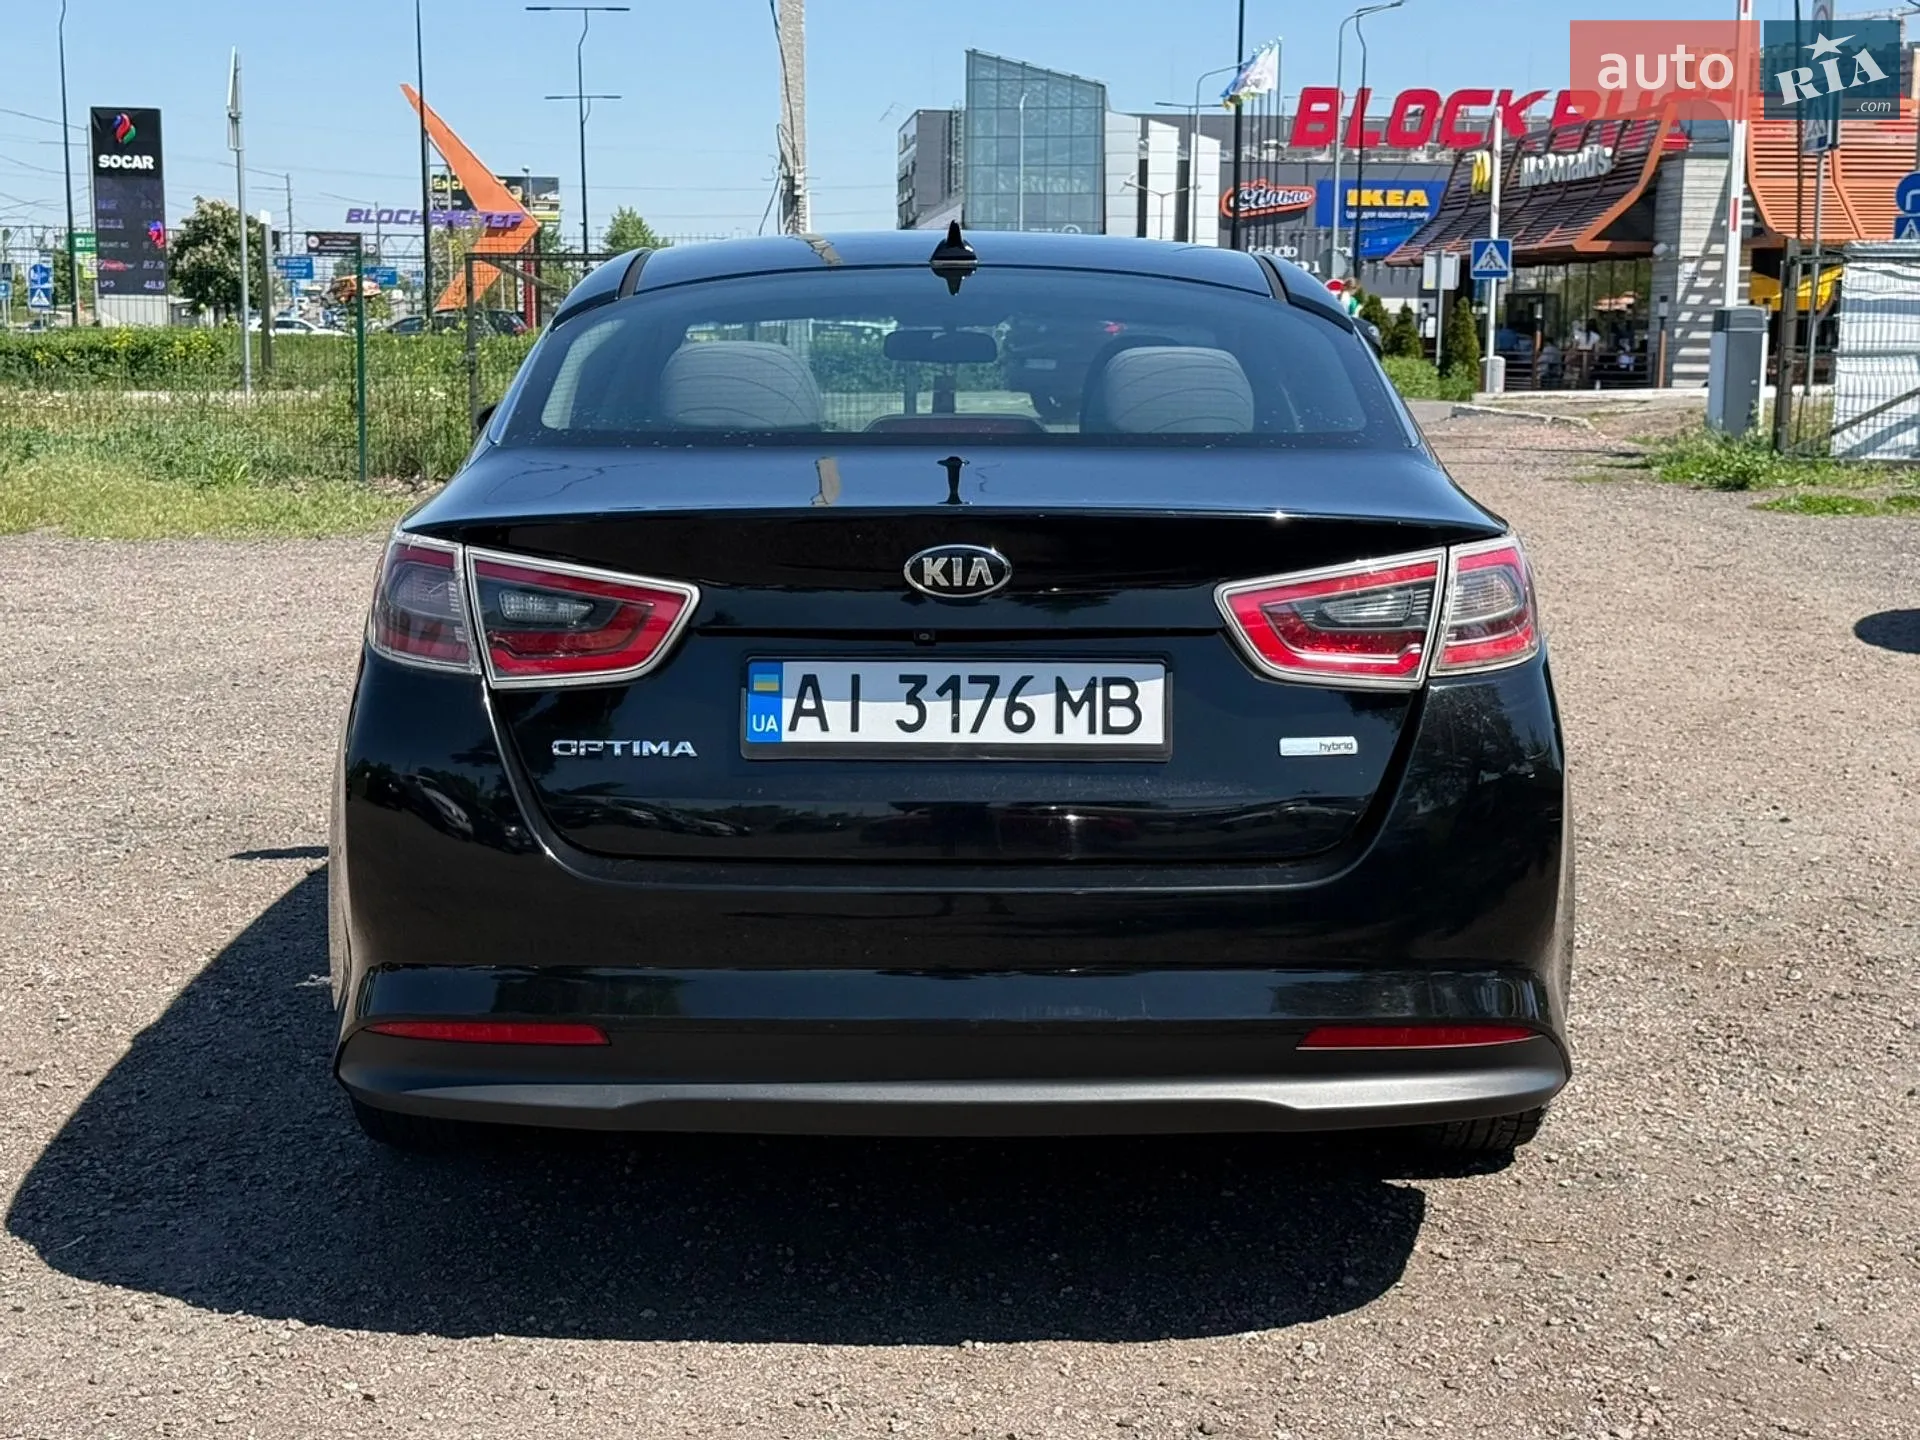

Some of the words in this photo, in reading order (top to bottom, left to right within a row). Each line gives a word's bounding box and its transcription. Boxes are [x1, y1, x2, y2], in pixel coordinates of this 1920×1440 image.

[98, 154, 154, 170] SOCAR
[1346, 188, 1430, 207] IKEA
[922, 557, 994, 587] KIA
[788, 673, 861, 733] AI
[896, 674, 1035, 734] 3176
[1055, 675, 1143, 735] MB
[752, 714, 779, 733] UA
[551, 739, 698, 757] OPTIMA
[1319, 742, 1353, 752] hybrid
